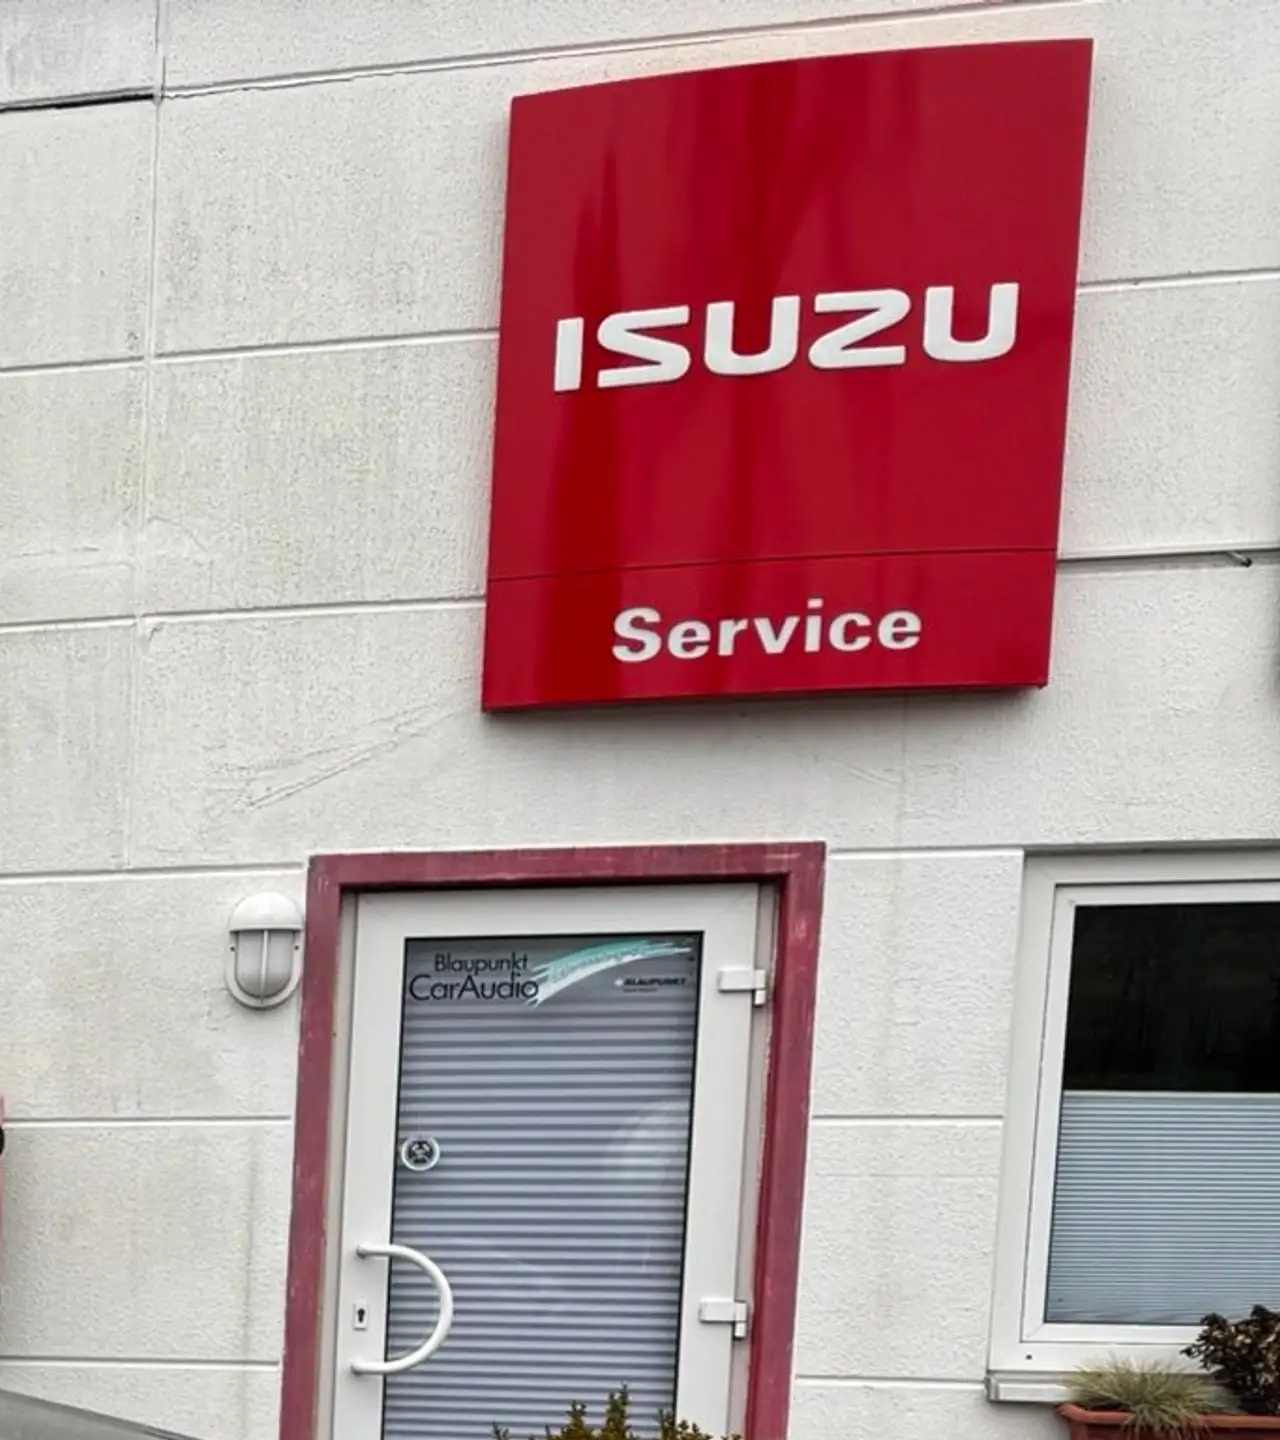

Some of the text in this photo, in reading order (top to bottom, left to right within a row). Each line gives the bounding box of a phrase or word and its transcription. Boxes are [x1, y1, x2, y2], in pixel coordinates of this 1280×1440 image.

[553, 282, 1020, 392] ISUZU
[612, 598, 922, 662] Service
[408, 971, 540, 1001] CarAudio
[434, 952, 528, 976] Blaupunkt
